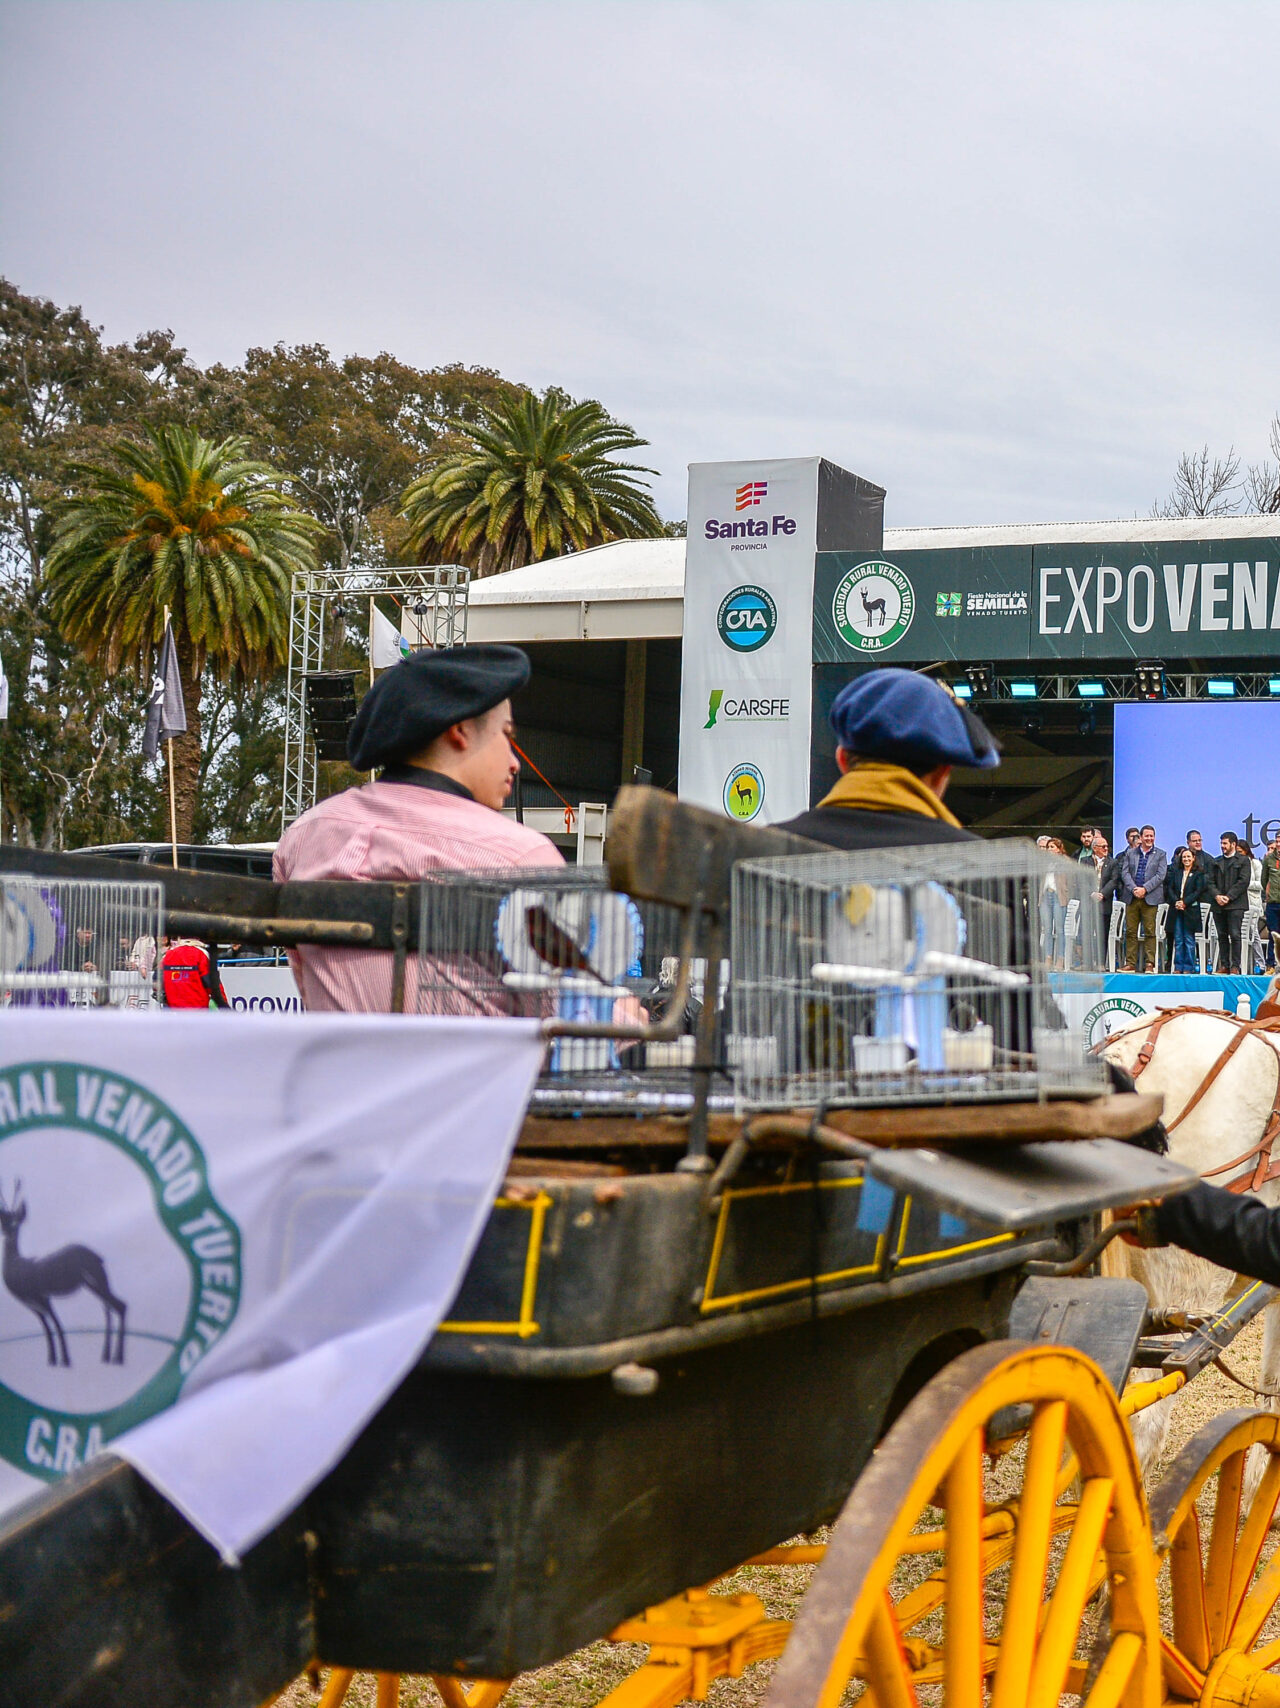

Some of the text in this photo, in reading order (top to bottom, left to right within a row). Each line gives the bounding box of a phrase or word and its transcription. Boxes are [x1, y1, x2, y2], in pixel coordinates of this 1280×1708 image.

[704, 515, 797, 541] Santa Fe
[730, 543, 768, 552] PROVINCIA
[835, 564, 912, 628] SOCIEDAD RURAL VENADO TUERTO
[966, 597, 1028, 610] SEMILLA
[985, 591, 1011, 599] Nacional
[860, 637, 884, 649] C.R.A.
[724, 699, 790, 716] CARSFE
[1093, 999, 1119, 1017] RURAL
[76, 1072, 200, 1209] VENADO
